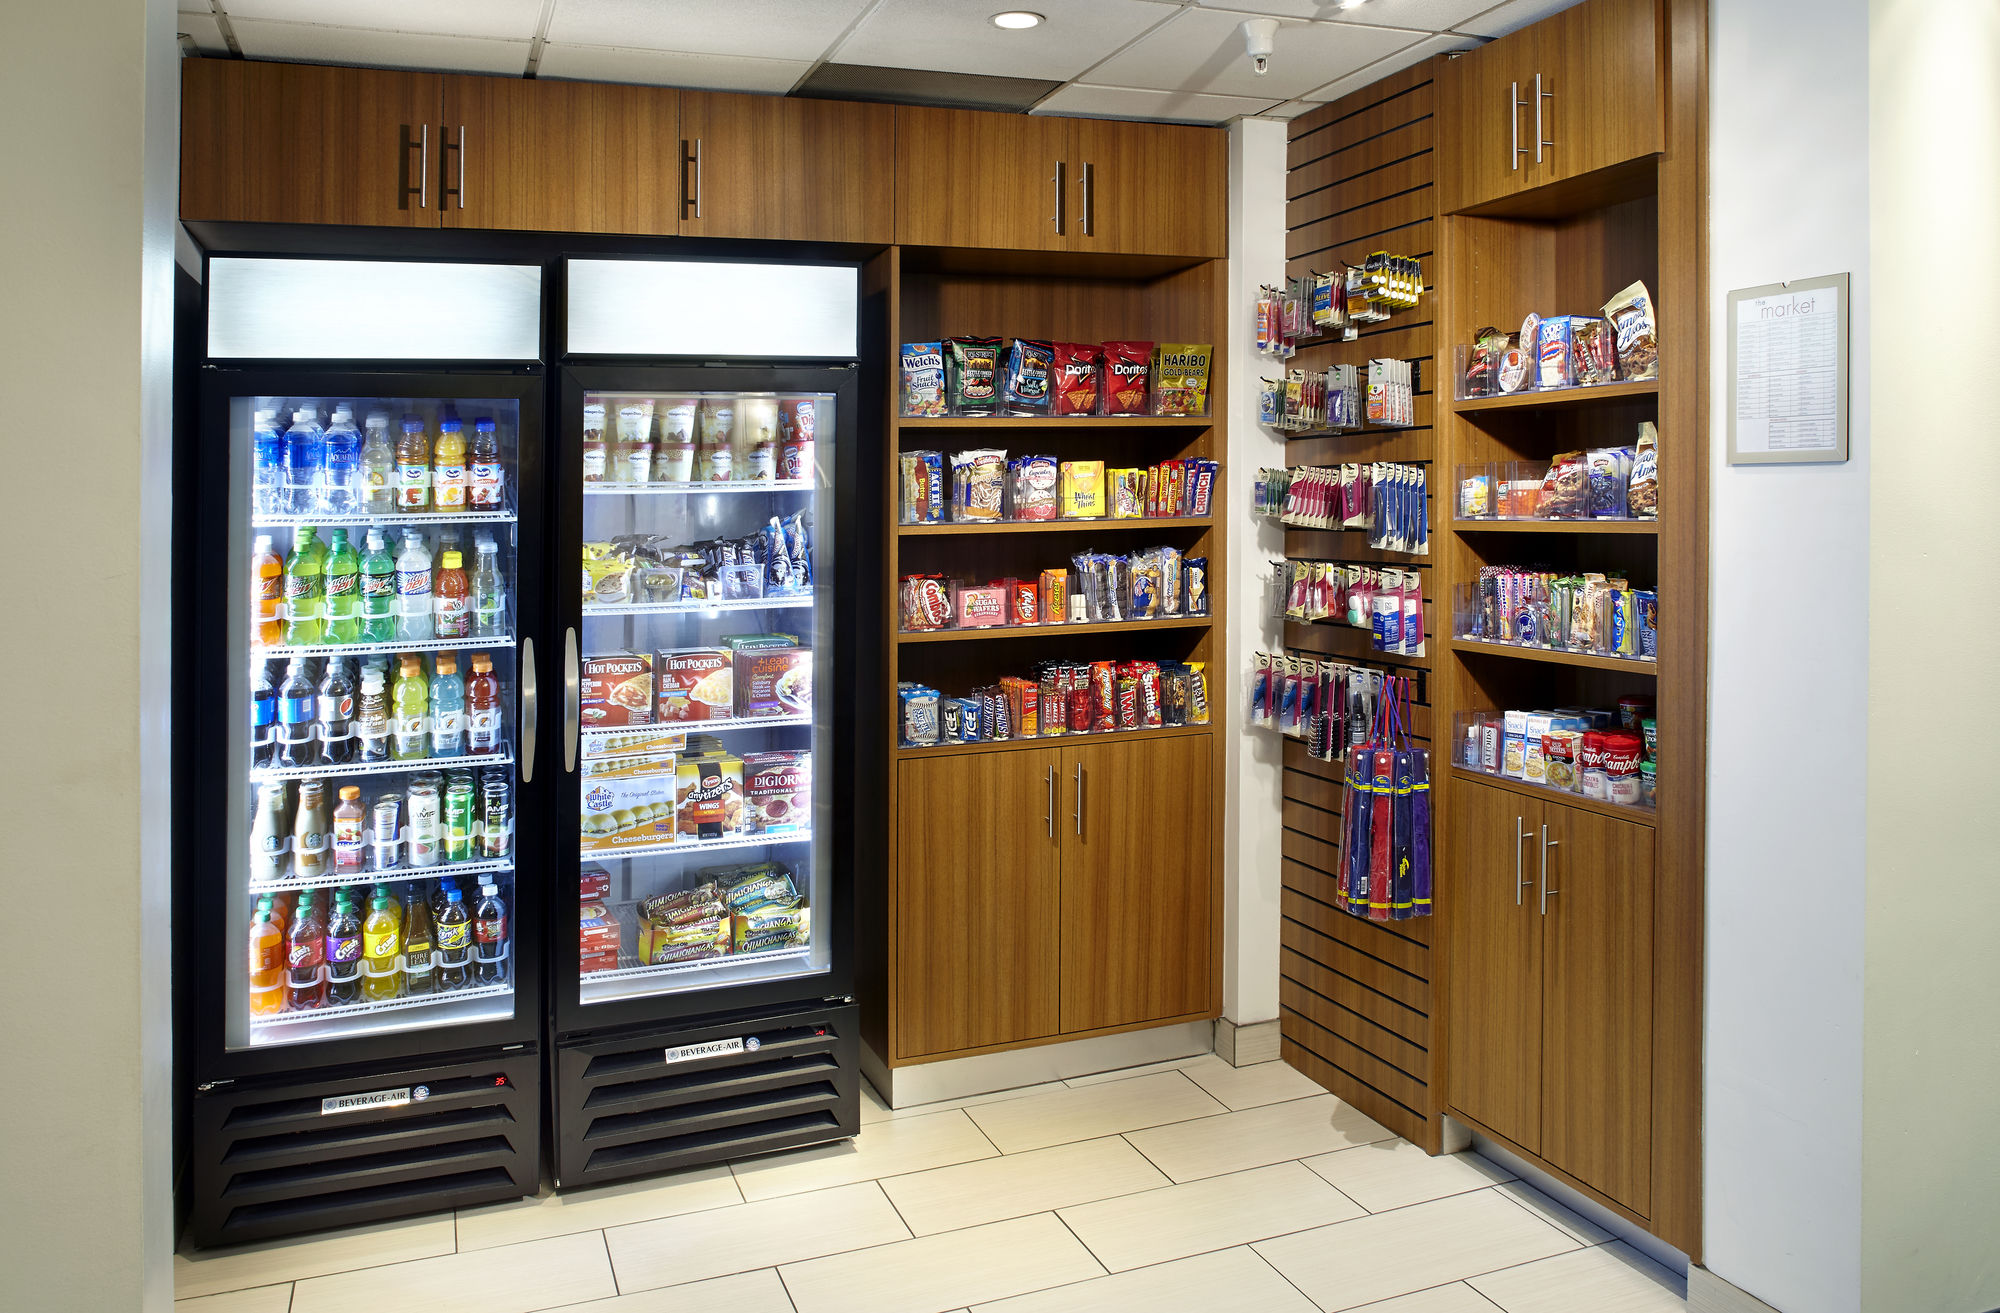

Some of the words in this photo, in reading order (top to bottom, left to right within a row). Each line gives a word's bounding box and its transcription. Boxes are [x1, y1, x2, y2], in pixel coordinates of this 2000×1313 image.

[1761, 296, 1816, 319] market
[904, 356, 941, 369] Welch's
[1065, 364, 1096, 375] Dorito
[1114, 364, 1148, 375] Doritos
[1164, 354, 1206, 366] HARIBO
[912, 381, 938, 390] Snacks
[916, 374, 934, 384] Fruit
[1074, 492, 1095, 501] Wheat
[1197, 474, 1209, 513] CRUNCH
[1074, 501, 1095, 509] Thins
[925, 582, 942, 622] Combos
[589, 664, 605, 674] HOT
[607, 662, 642, 673] POCKETS
[670, 659, 686, 669] HOT
[687, 657, 722, 668] POCKETS
[1142, 673, 1156, 717] Skittles
[983, 696, 994, 737] SNICKERS
[996, 695, 1008, 735] SNICKERS
[1120, 686, 1135, 728] TWIX
[945, 711, 958, 737] ICE
[965, 711, 976, 736] ICE
[1485, 729, 1493, 764] ALTOIDS
[589, 793, 612, 802] White
[611, 832, 673, 844] Cheeseburgers
[336, 939, 359, 959] Crush
[376, 934, 397, 955] Crush
[742, 931, 796, 952] CHIMICHANGAS
[289, 945, 310, 963] Crush
[659, 942, 714, 962] CHIMICHANGAS
